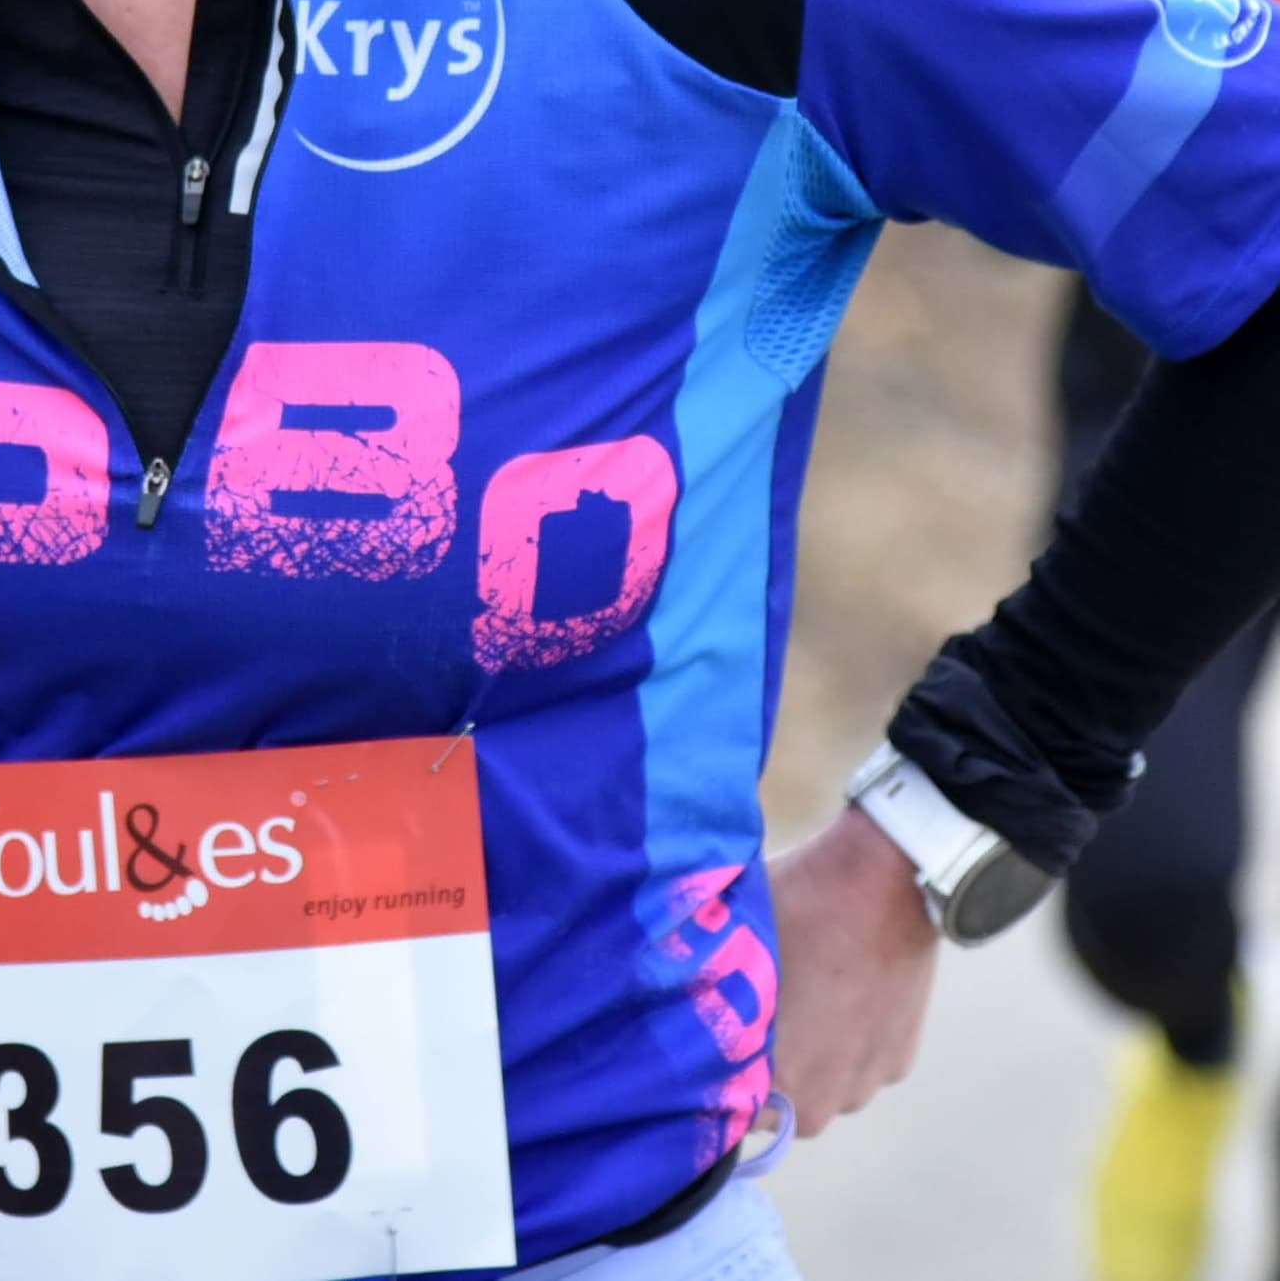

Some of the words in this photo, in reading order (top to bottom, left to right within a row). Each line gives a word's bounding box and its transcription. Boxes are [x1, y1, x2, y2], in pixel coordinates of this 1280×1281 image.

[296, 0, 484, 102] Krys
[304, 893, 367, 921] enjoy
[374, 884, 466, 910] running
